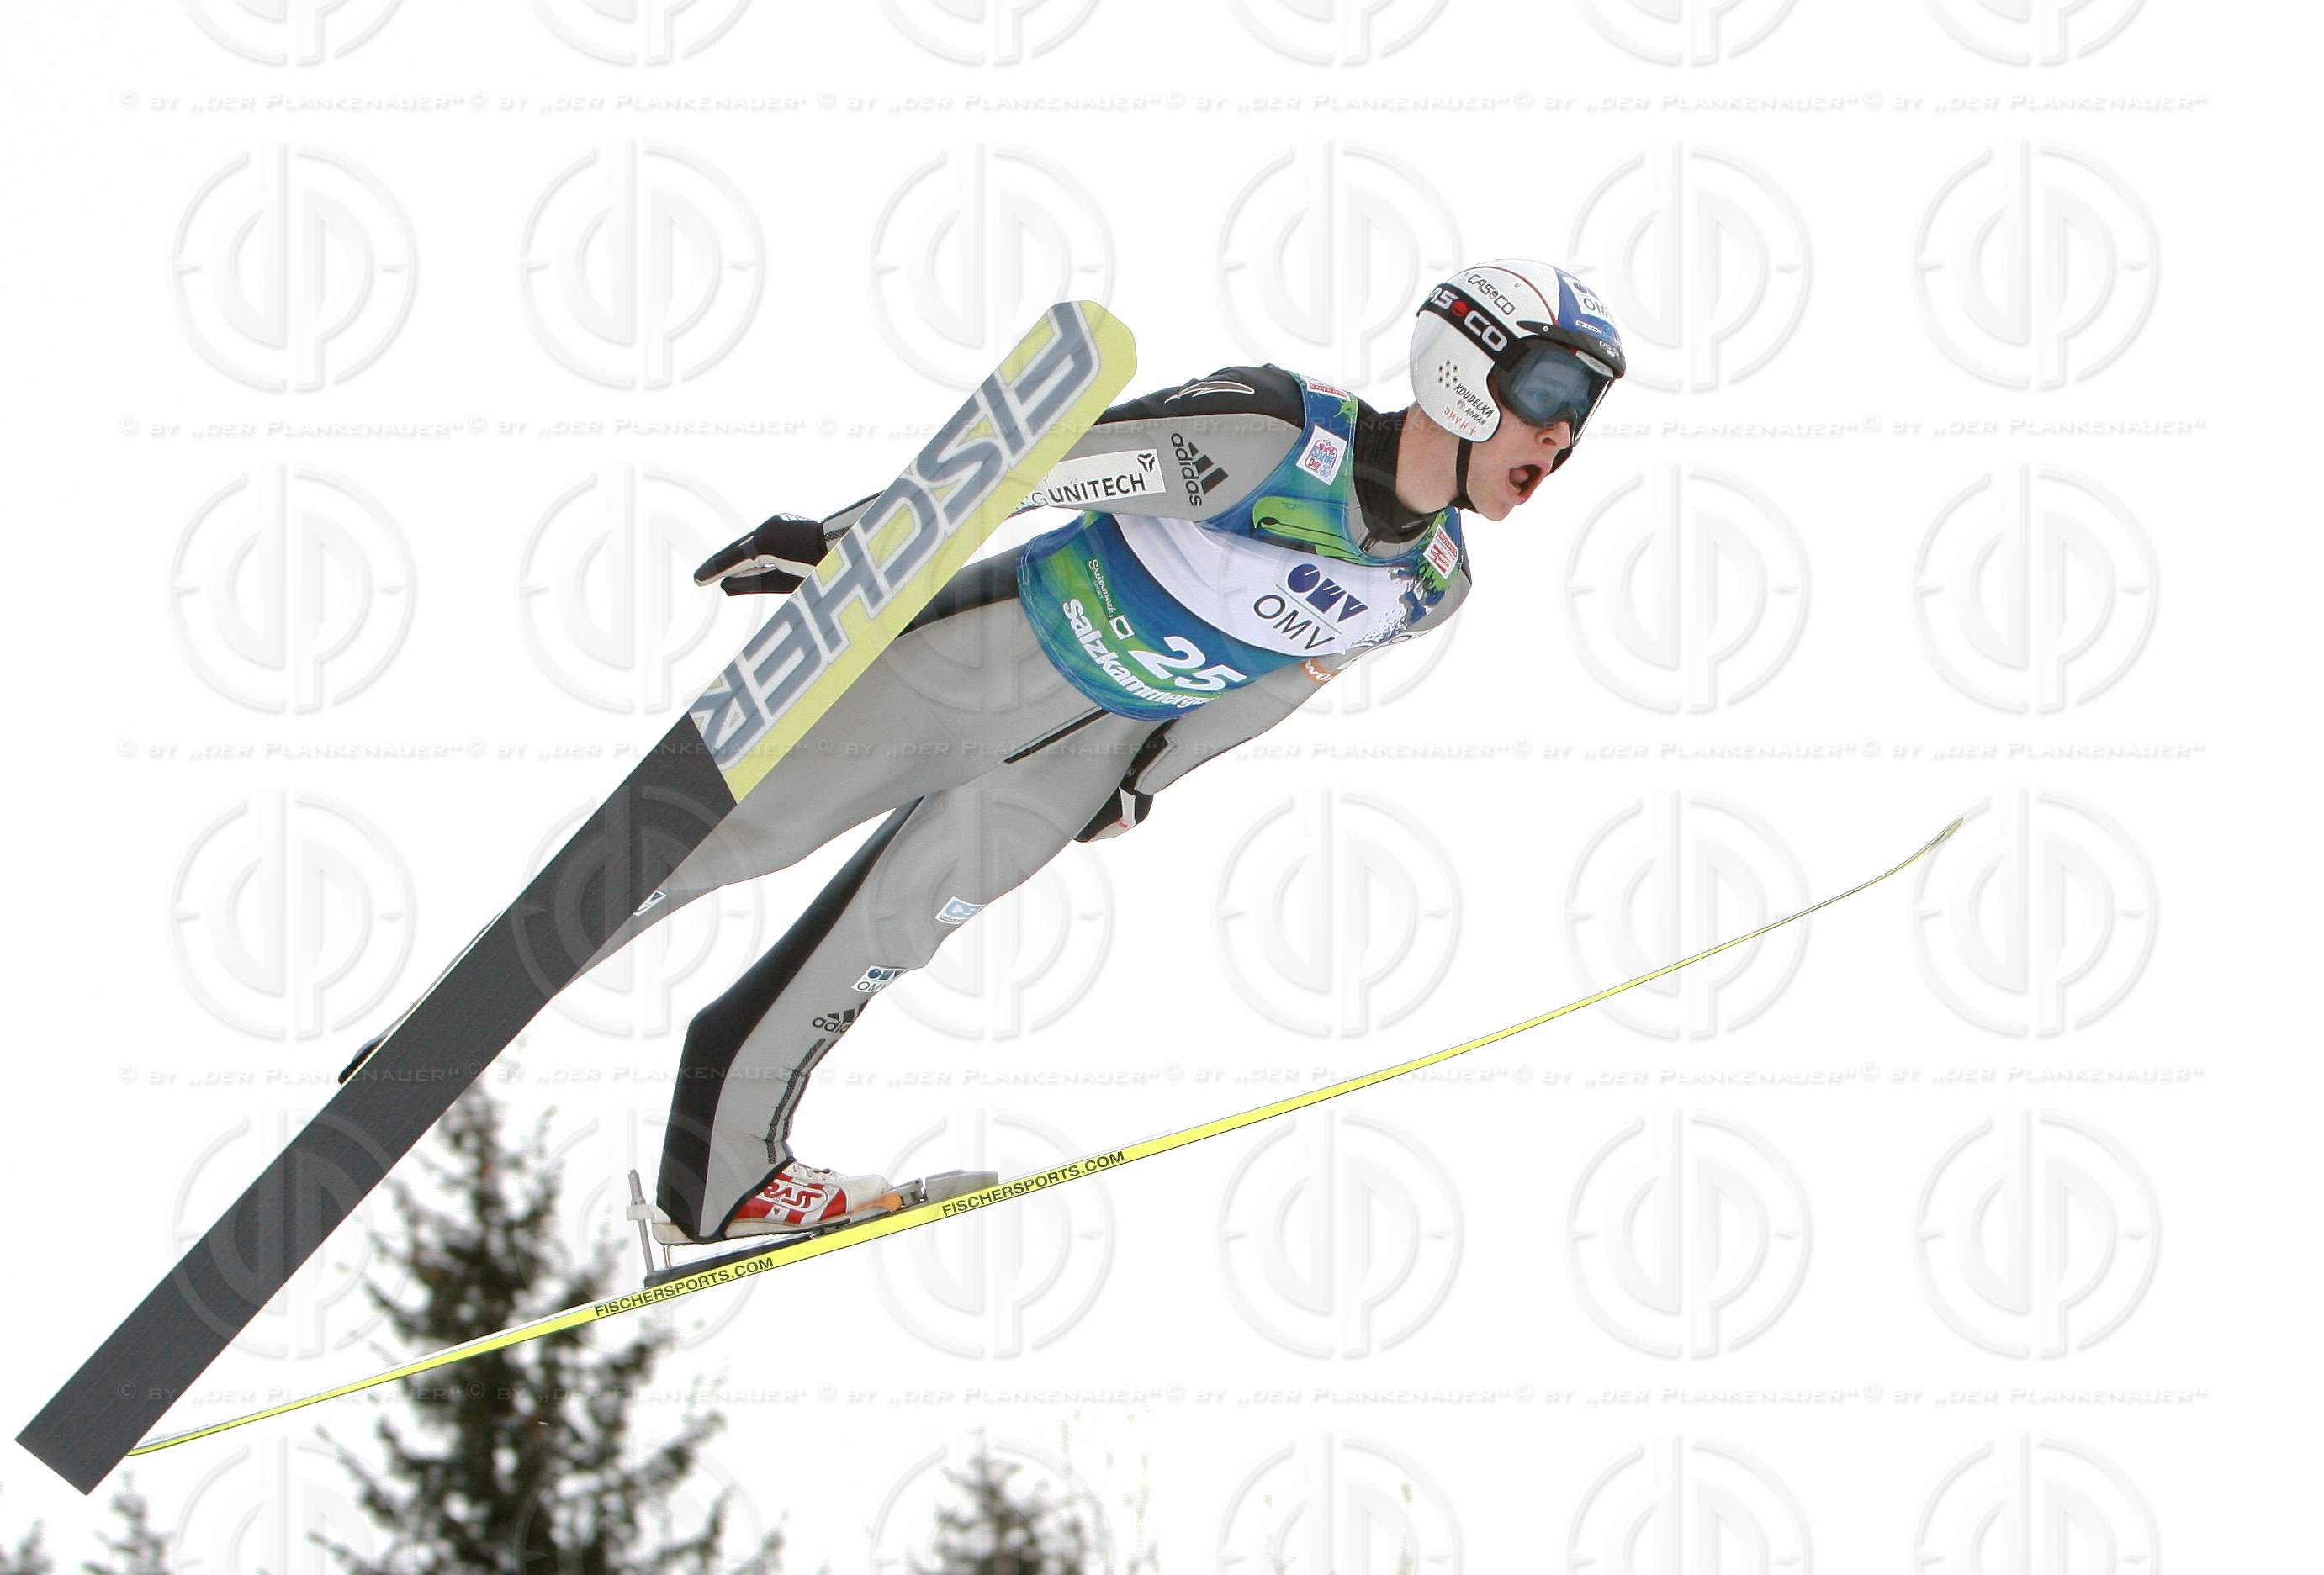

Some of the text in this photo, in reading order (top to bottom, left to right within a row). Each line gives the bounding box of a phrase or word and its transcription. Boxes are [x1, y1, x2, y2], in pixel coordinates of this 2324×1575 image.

[1453, 383, 1495, 418] KOUDELKA
[1047, 473, 1147, 504] UNITECH
[1170, 432, 1204, 506] adidas
[688, 301, 1100, 769] FISCHER
[1252, 594, 1337, 651] OMV
[1128, 635, 1248, 691] 25
[942, 1151, 1125, 1218] FISCHERSPORTS.COM
[594, 1257, 775, 1318] FISCHERSPORTS.COM
